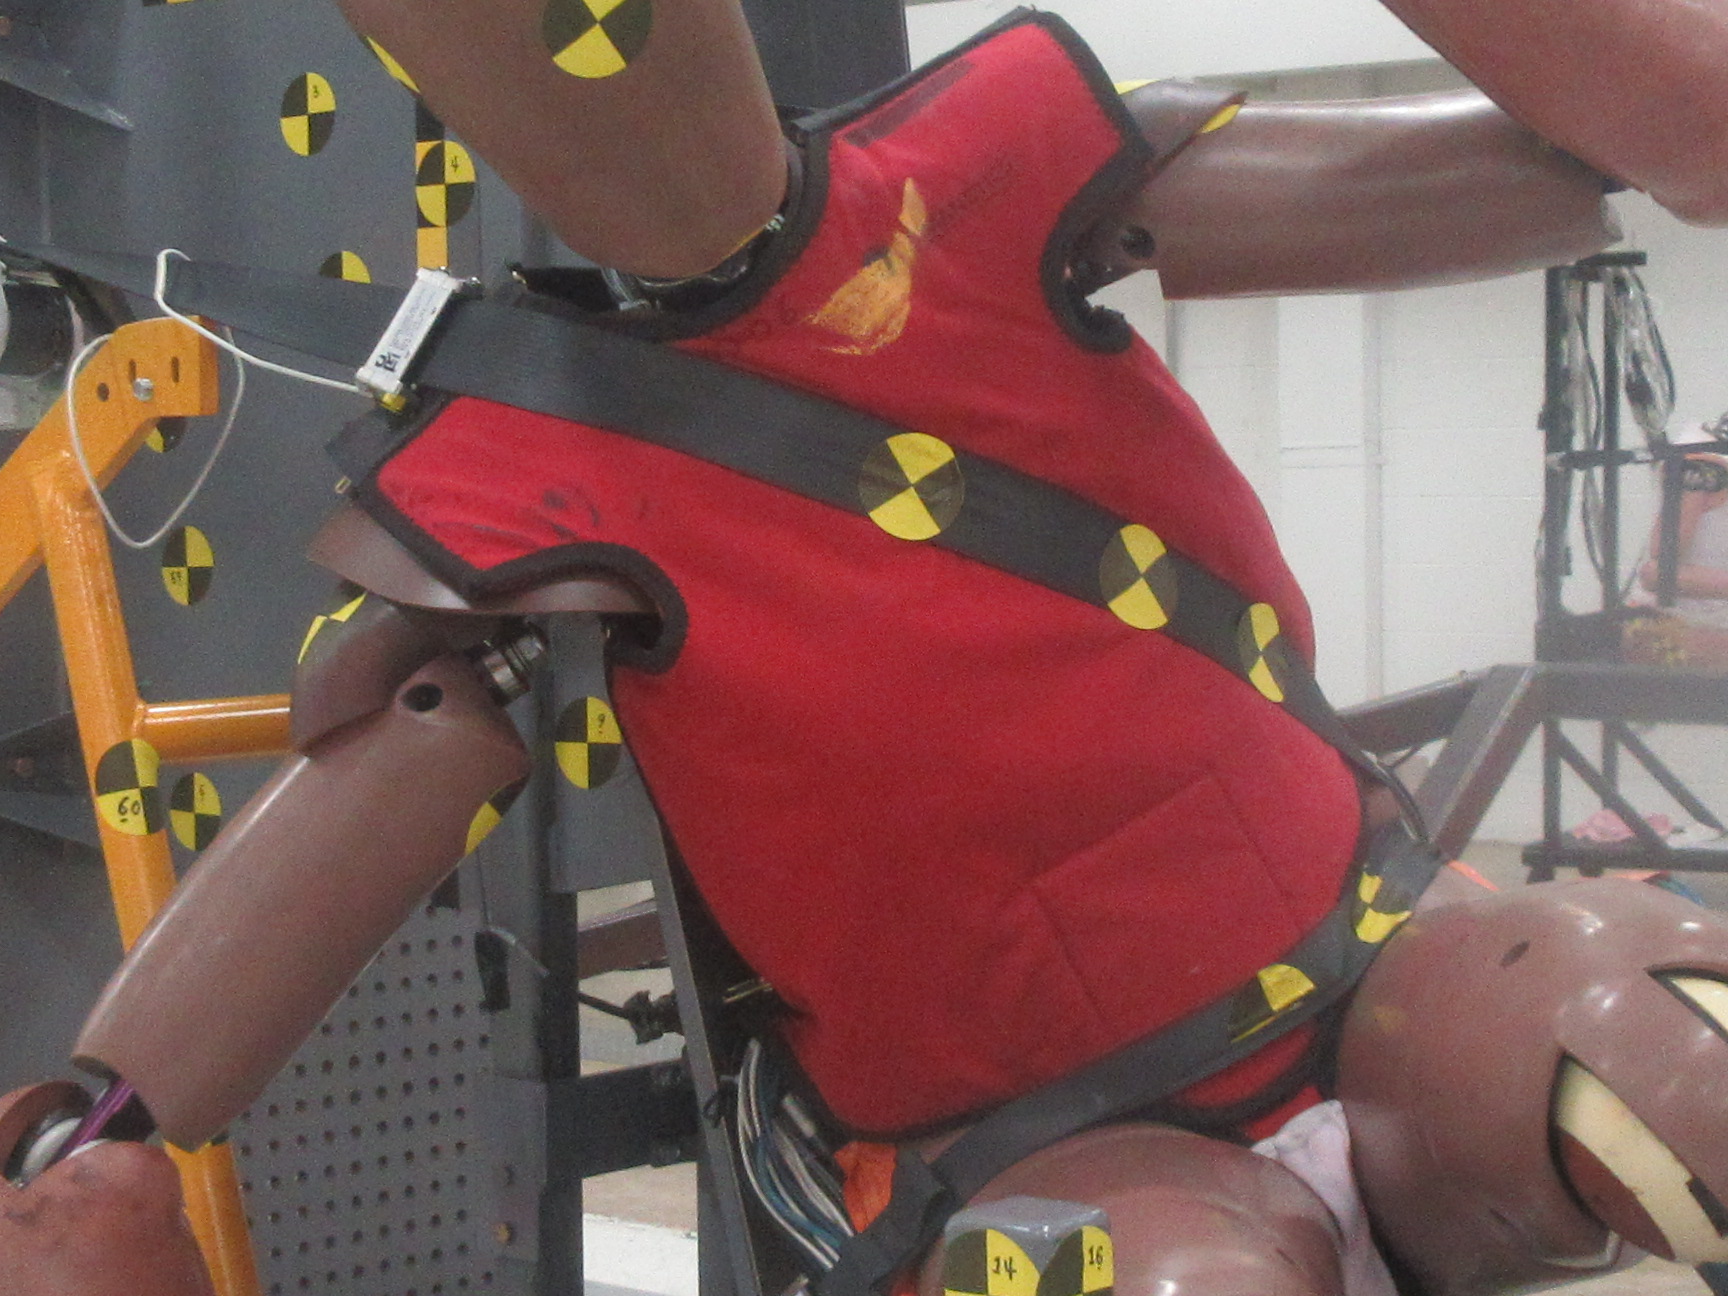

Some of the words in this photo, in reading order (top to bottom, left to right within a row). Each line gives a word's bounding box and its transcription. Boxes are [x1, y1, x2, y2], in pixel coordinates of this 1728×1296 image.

[450, 154, 459, 172] 4
[117, 796, 141, 819] 60
[1088, 1245, 1104, 1268] 16
[991, 1255, 1018, 1282] 14
